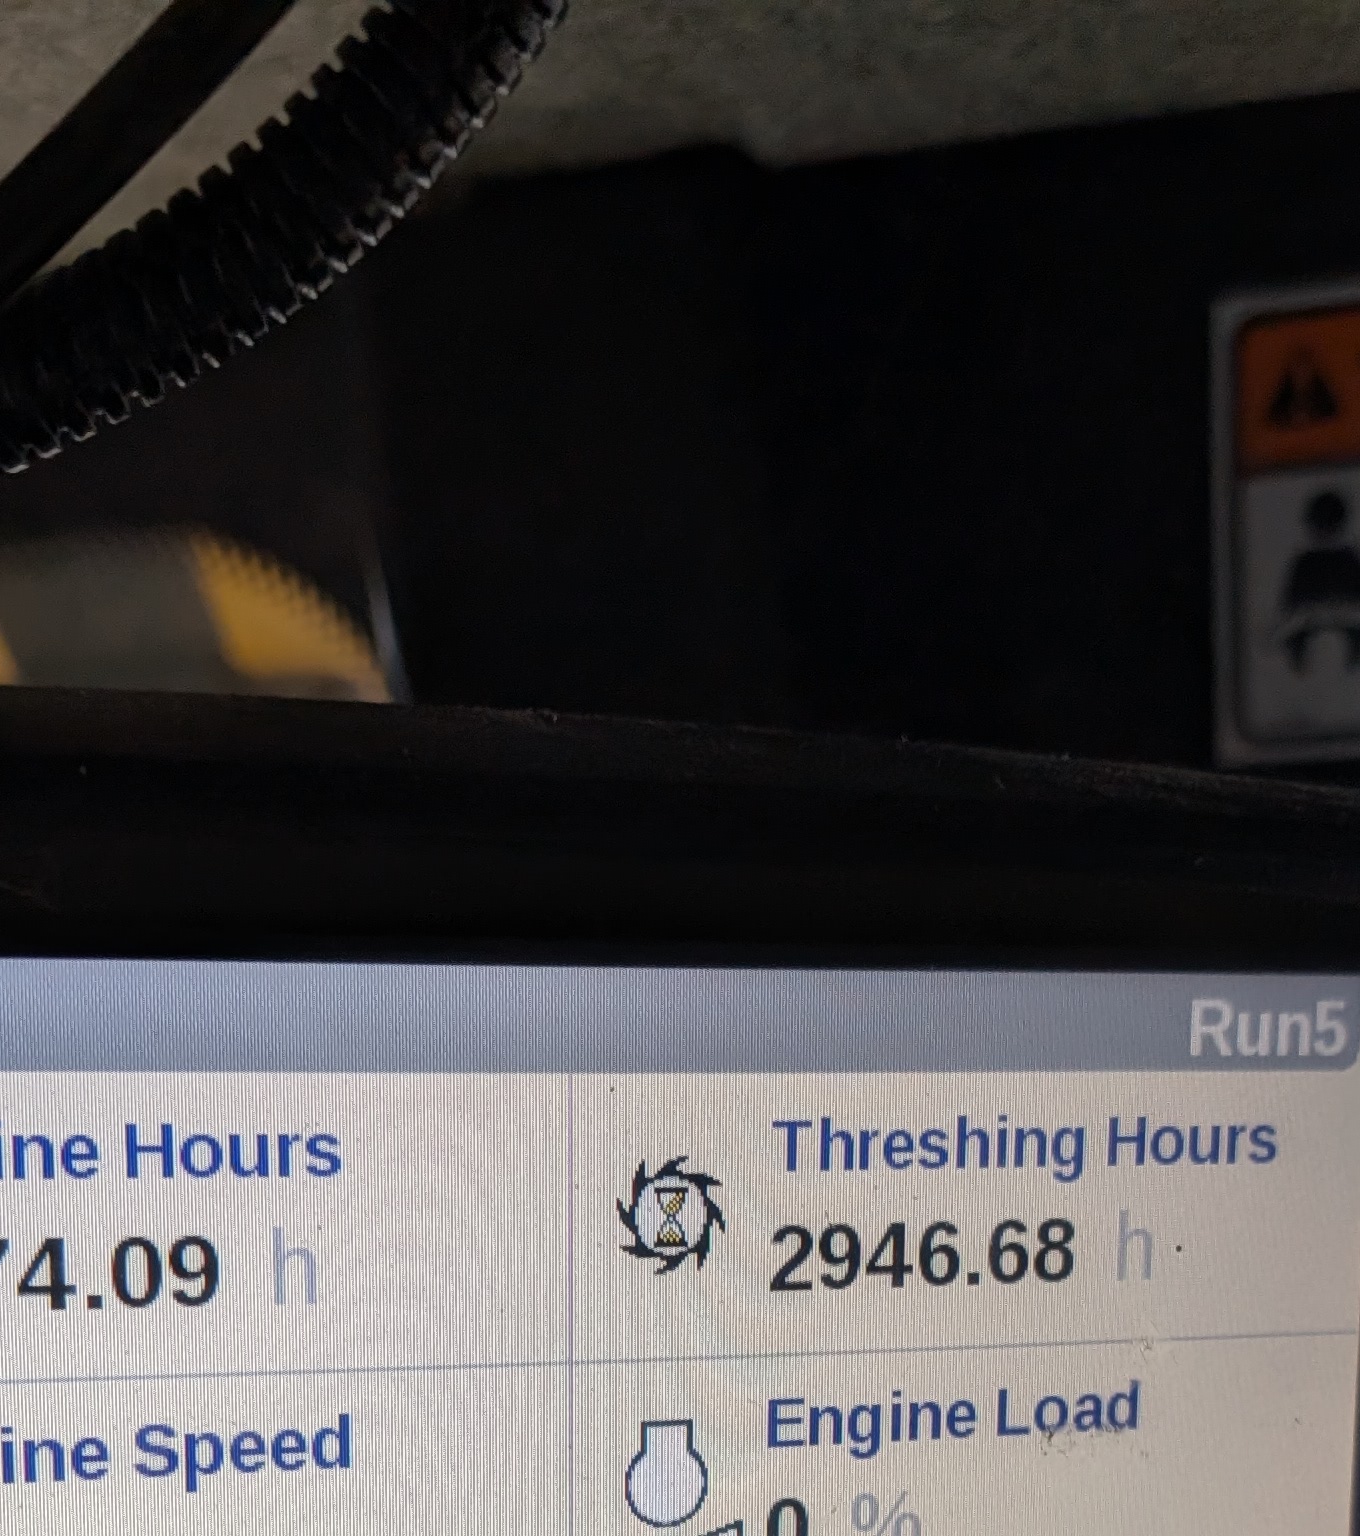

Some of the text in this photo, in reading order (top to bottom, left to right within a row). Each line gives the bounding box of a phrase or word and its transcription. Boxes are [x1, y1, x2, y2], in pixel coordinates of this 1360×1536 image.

[1190, 999, 1346, 1057] Run5
[124, 1123, 342, 1179] Hours
[772, 1114, 1277, 1183] Threshing Hours
[273, 1227, 317, 1305] h
[769, 1210, 1153, 1292] 2946.68 h
[134, 1413, 352, 1493] Speed
[766, 1380, 1141, 1460] Engine Load
